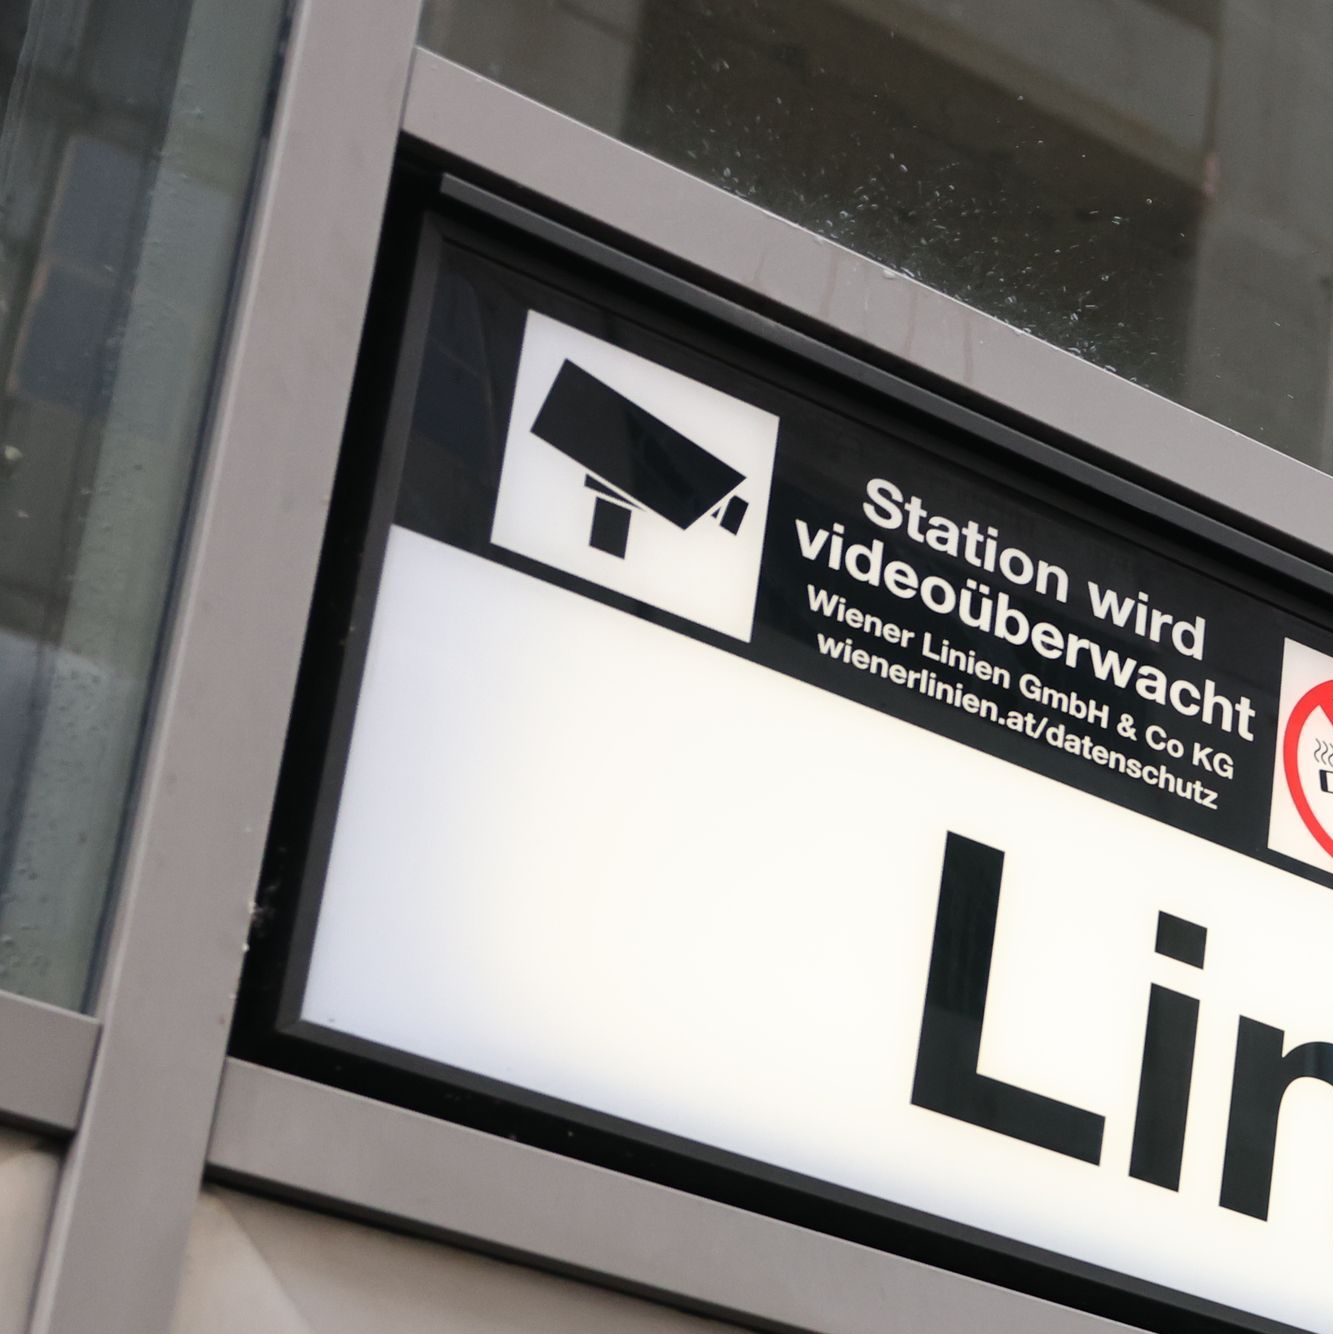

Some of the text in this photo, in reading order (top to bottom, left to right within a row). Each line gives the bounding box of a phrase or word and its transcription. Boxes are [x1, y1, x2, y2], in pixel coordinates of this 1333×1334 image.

[796, 520, 1256, 742] videoüberwacht
[863, 479, 1205, 661] Station wird
[807, 585, 1234, 780] Wiener Linien GmbH & Co KG
[817, 634, 1217, 810] wienerlinien.at/datenschutz
